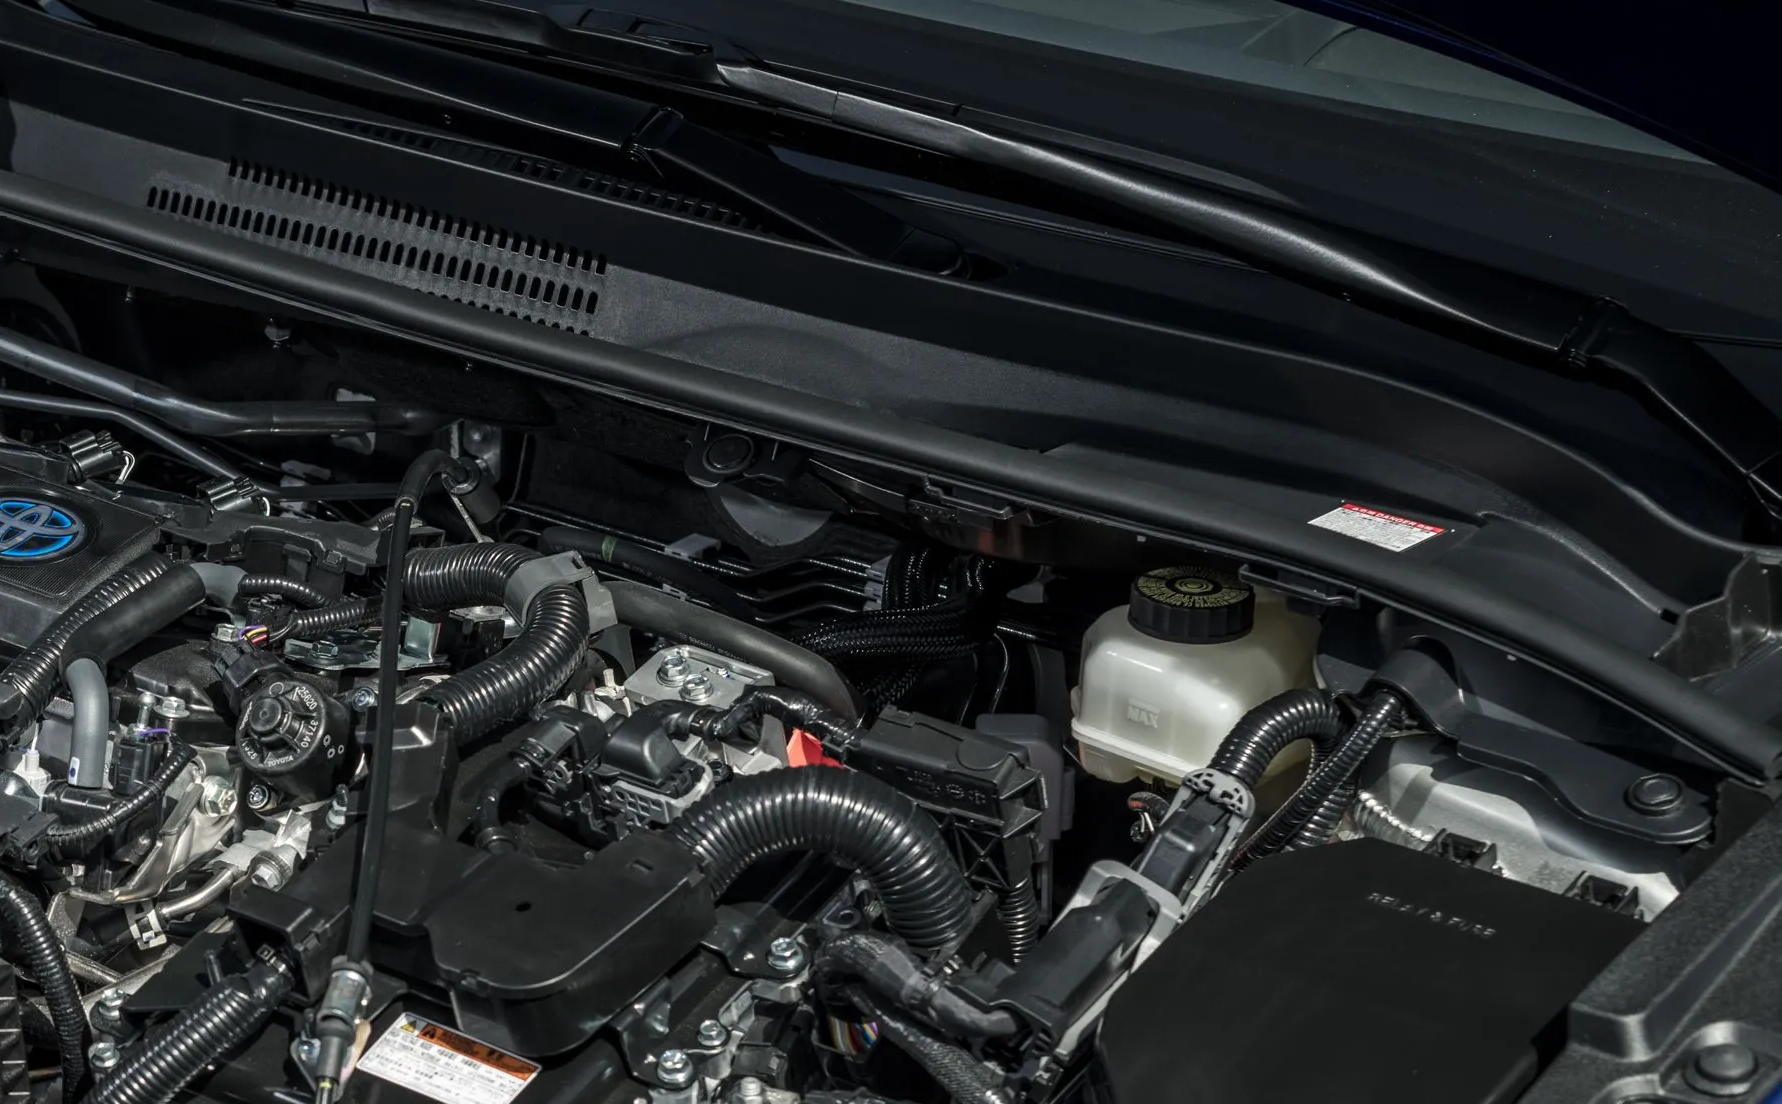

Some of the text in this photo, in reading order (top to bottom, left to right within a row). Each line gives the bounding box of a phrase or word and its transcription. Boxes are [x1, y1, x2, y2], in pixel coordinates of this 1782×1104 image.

[297, 685, 318, 710] 25620
[1126, 704, 1159, 729] MAX
[300, 719, 319, 749] 37140
[267, 754, 294, 767] TOYOTA
